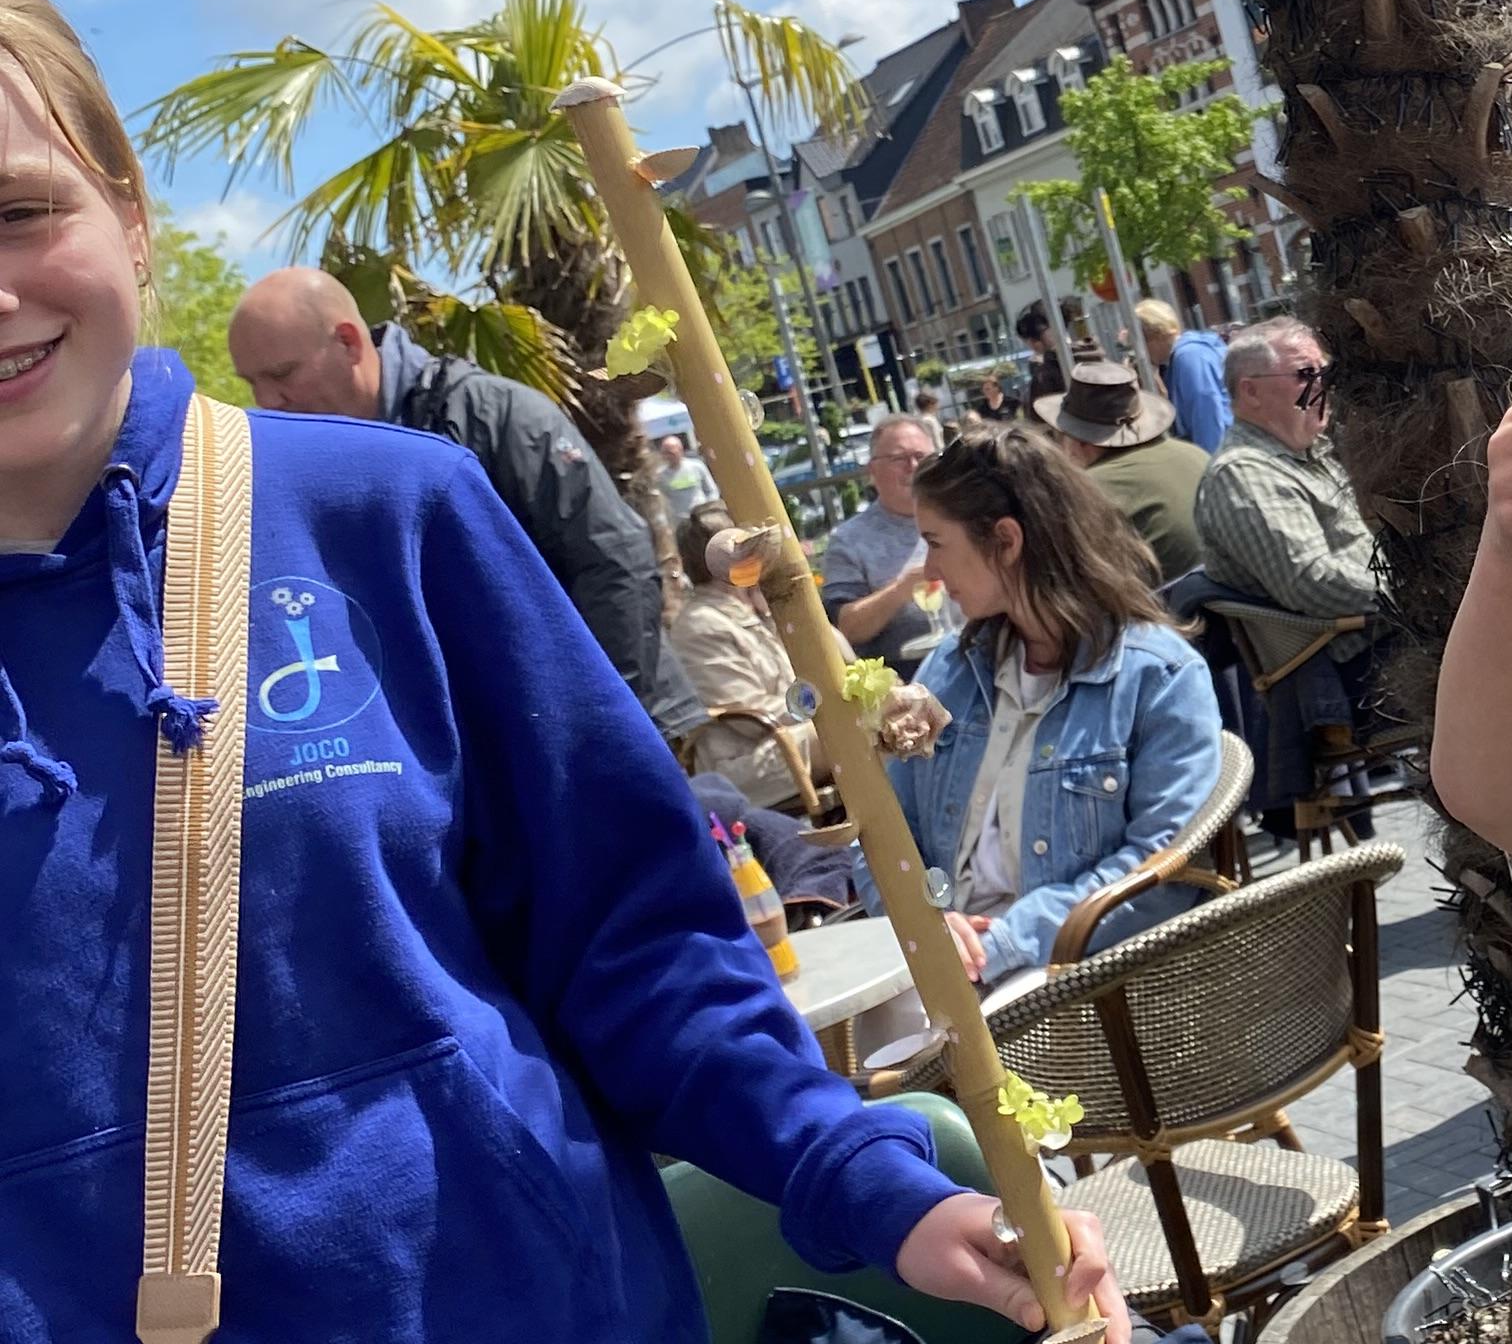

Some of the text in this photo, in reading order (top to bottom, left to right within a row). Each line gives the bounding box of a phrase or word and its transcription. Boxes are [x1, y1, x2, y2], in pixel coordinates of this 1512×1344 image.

[289, 736, 350, 766] JOCO
[242, 759, 403, 799] ngineering Consultancy
